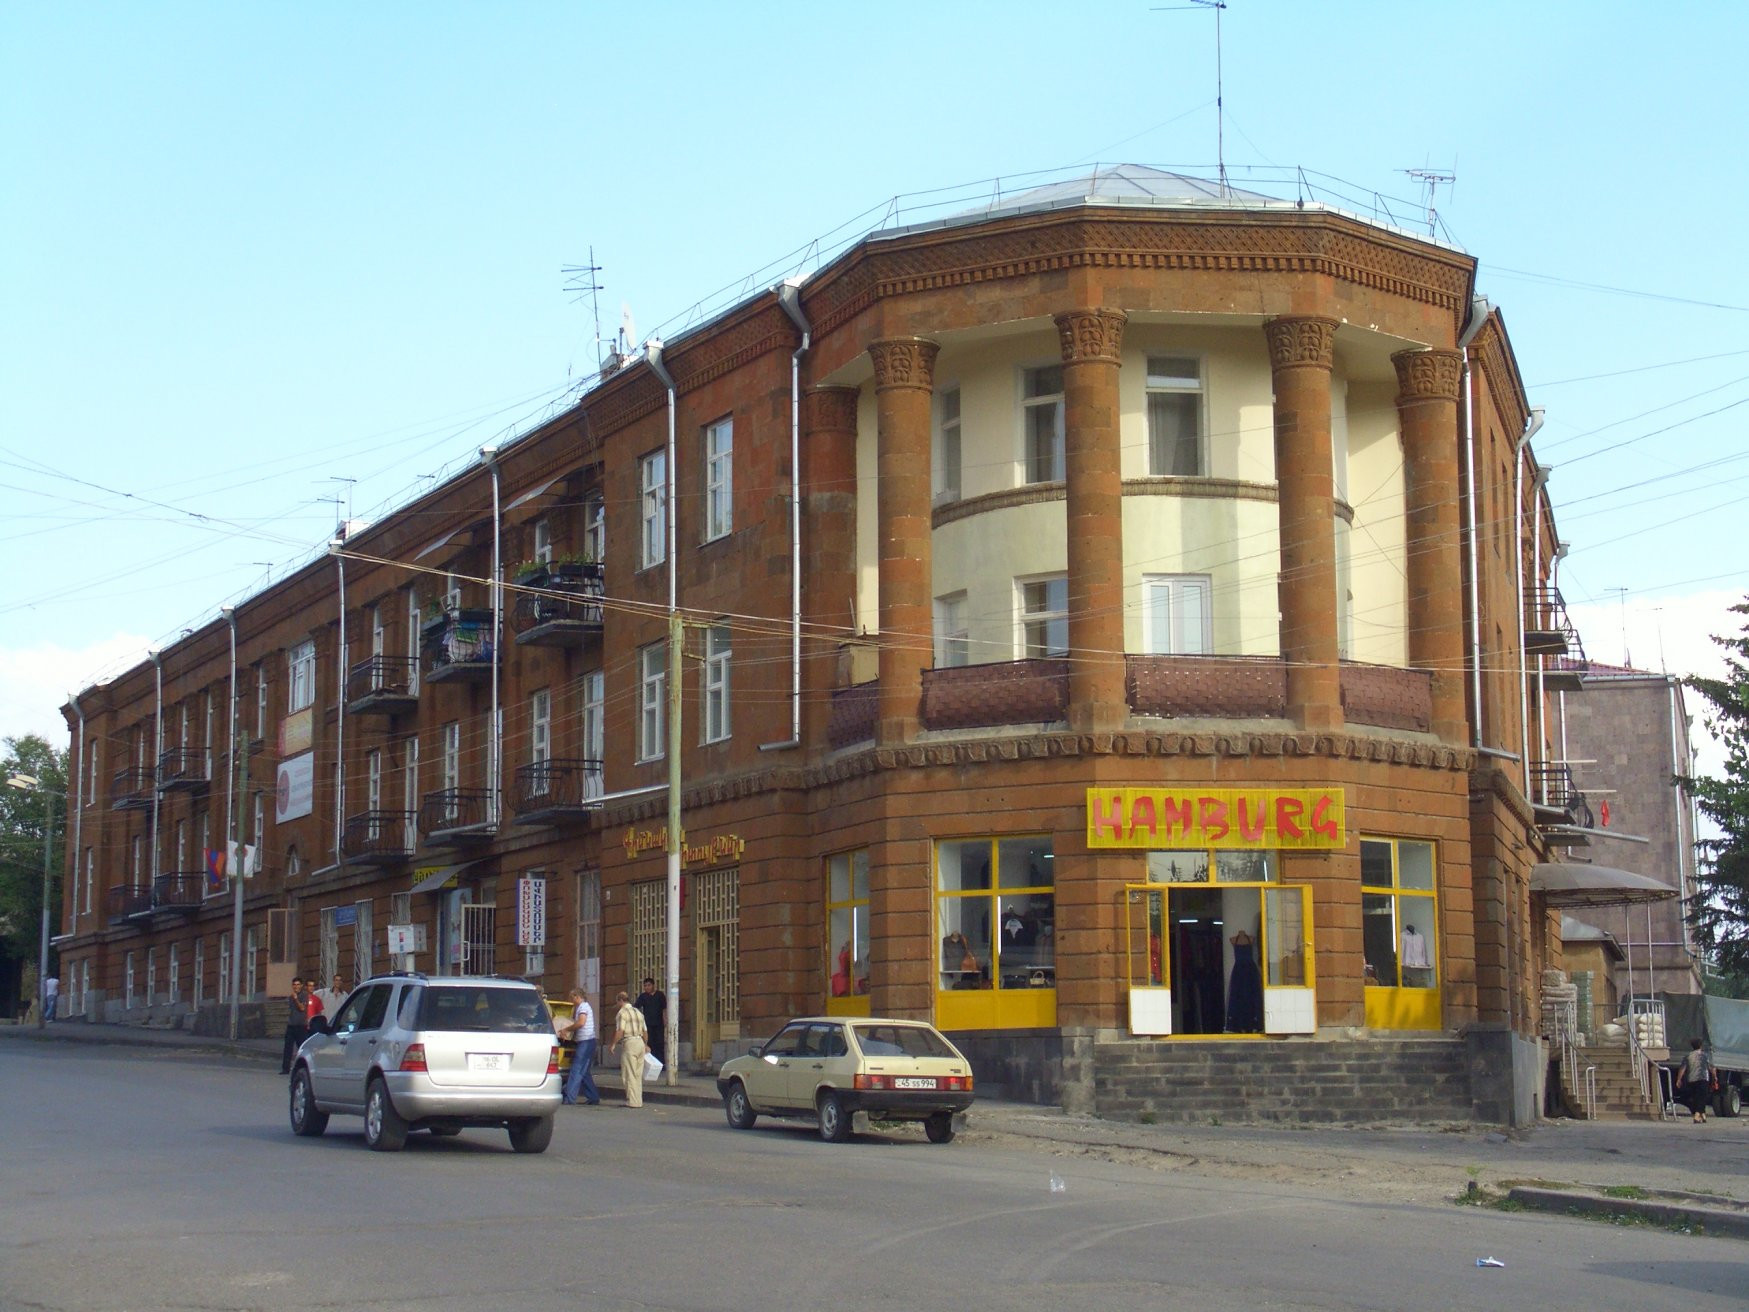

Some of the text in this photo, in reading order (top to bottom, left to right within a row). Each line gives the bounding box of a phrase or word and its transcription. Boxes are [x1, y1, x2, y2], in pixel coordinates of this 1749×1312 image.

[1092, 795, 1338, 842] HAMBURG
[901, 1078, 910, 1087] 45
[920, 1079, 934, 1087] 994
